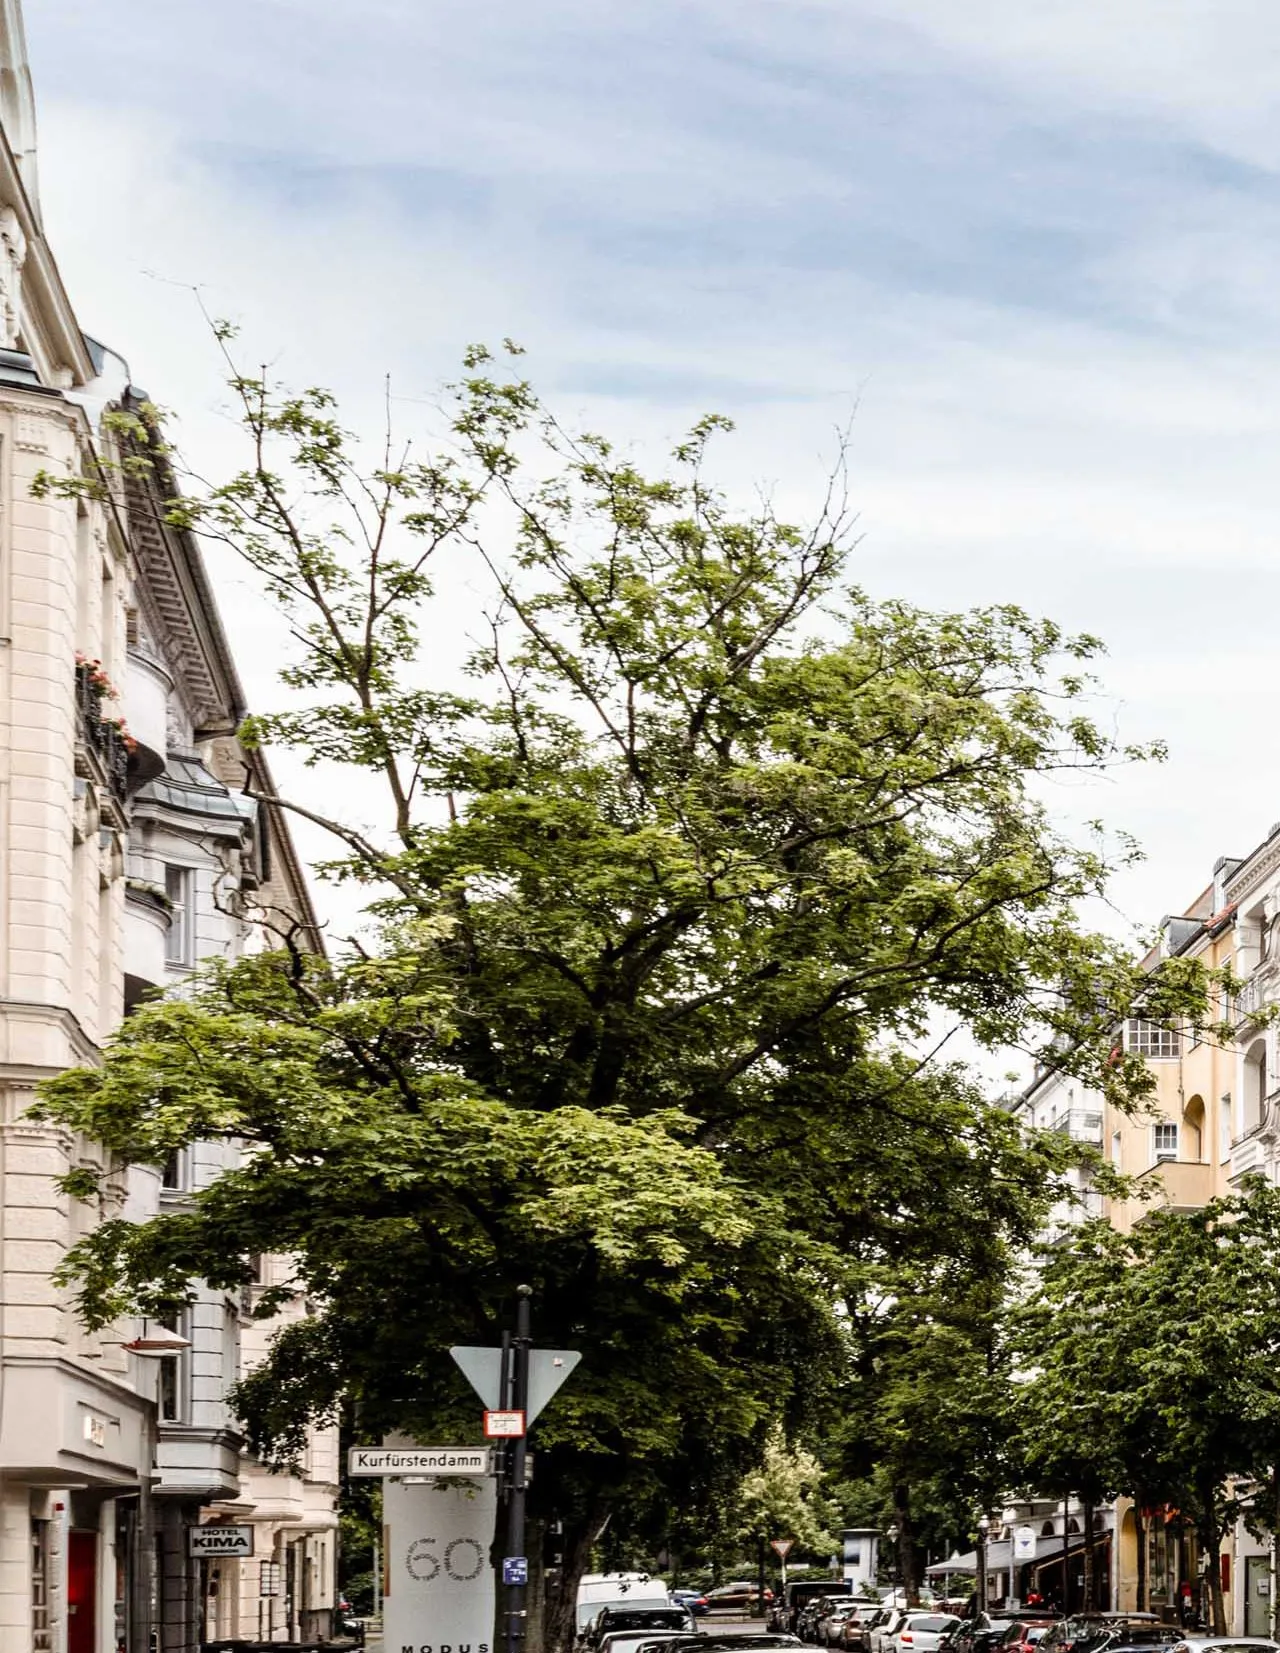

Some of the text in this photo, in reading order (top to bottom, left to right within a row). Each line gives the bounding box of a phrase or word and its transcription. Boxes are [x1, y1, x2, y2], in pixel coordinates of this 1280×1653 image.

[358, 1453, 481, 1467] Kurfürstendamm
[194, 1537, 248, 1548] KIMA
[401, 1643, 489, 1653] MODUS
